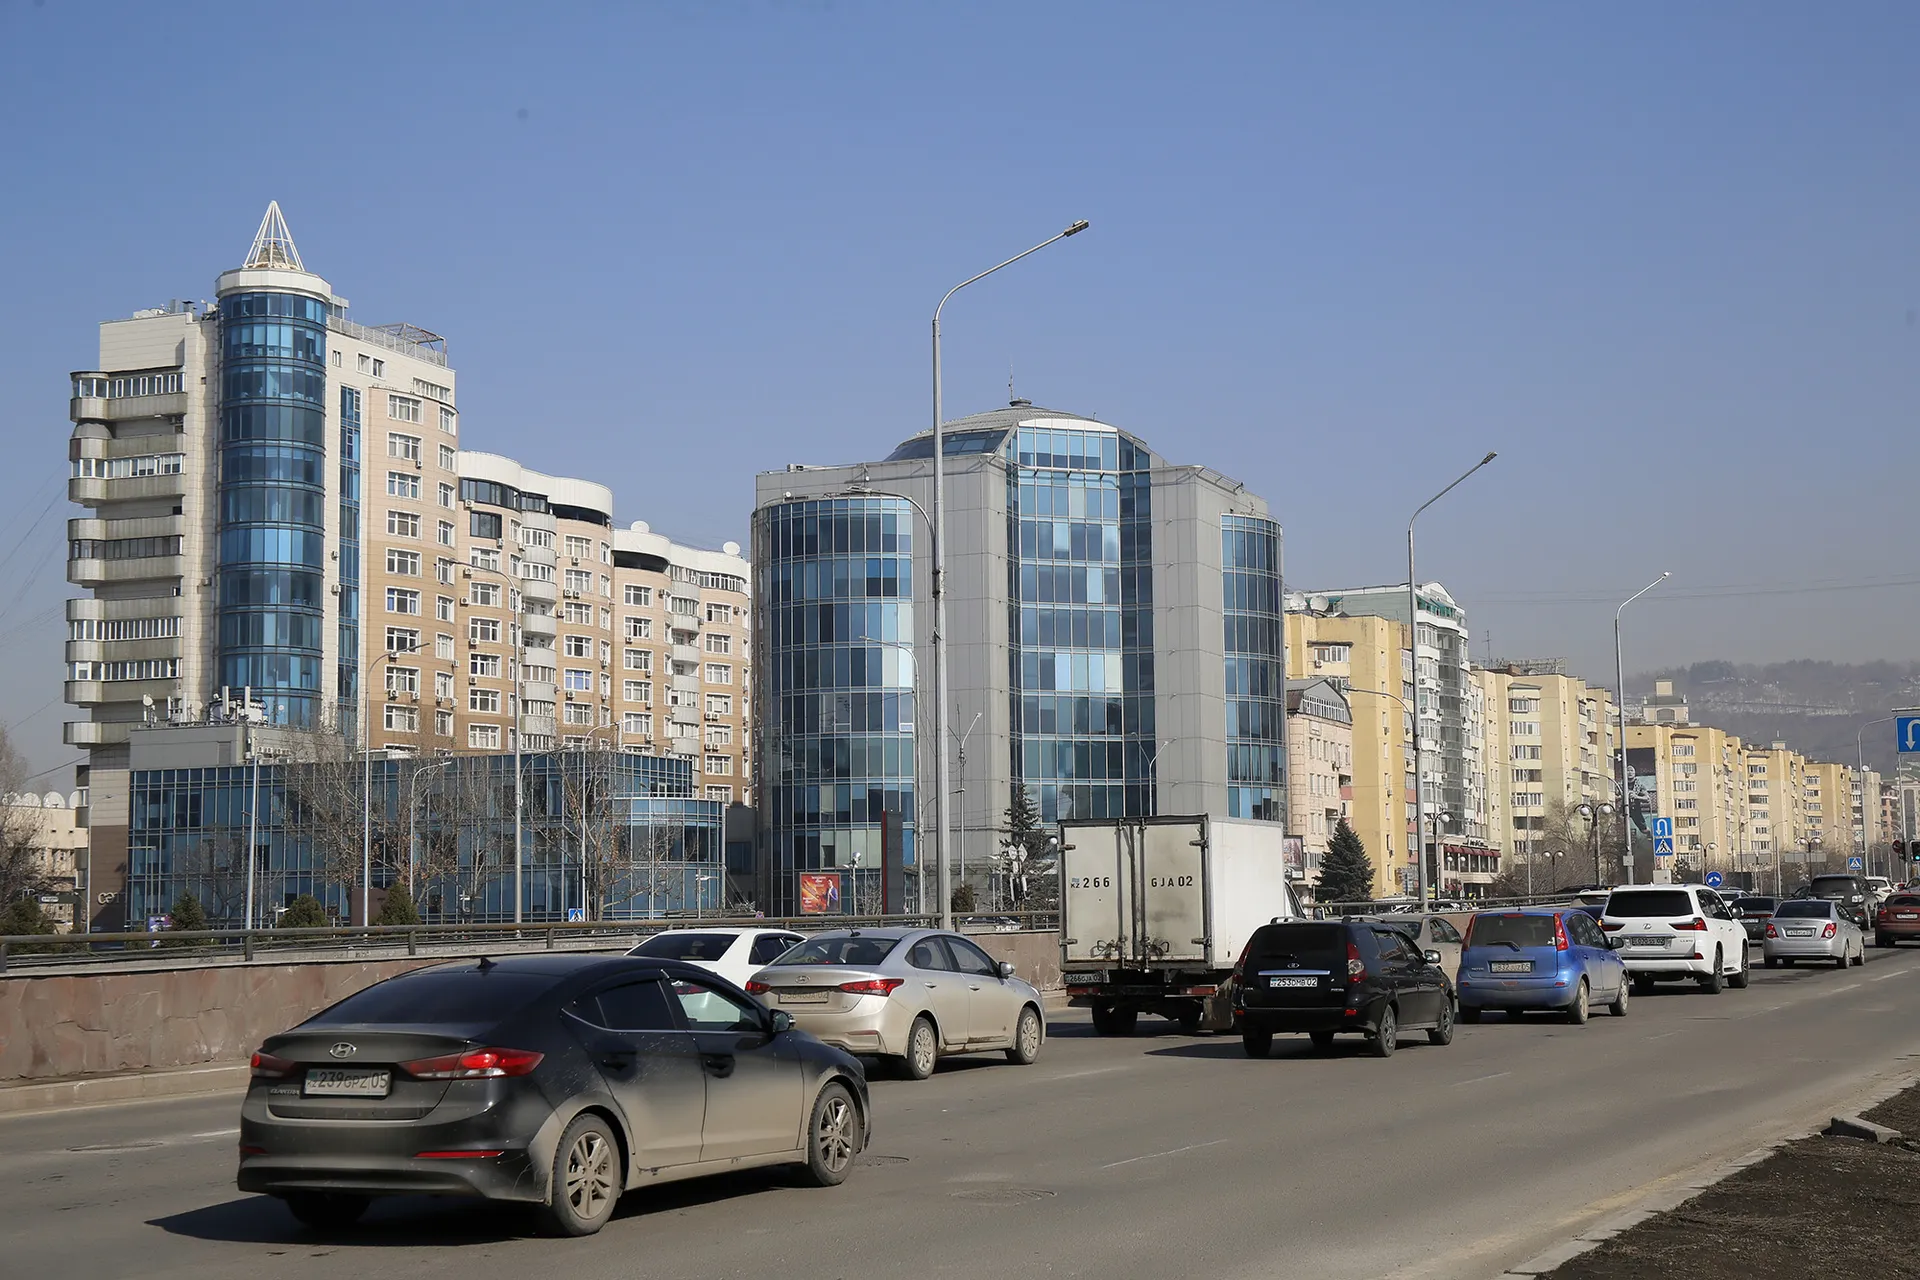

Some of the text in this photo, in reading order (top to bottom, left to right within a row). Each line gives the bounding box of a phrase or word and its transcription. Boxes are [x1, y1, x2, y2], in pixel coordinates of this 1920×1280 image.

[1082, 876, 1110, 888] 266
[1151, 877, 1175, 888] GJA
[1177, 875, 1193, 887] 02
[371, 1072, 389, 1089] 05
